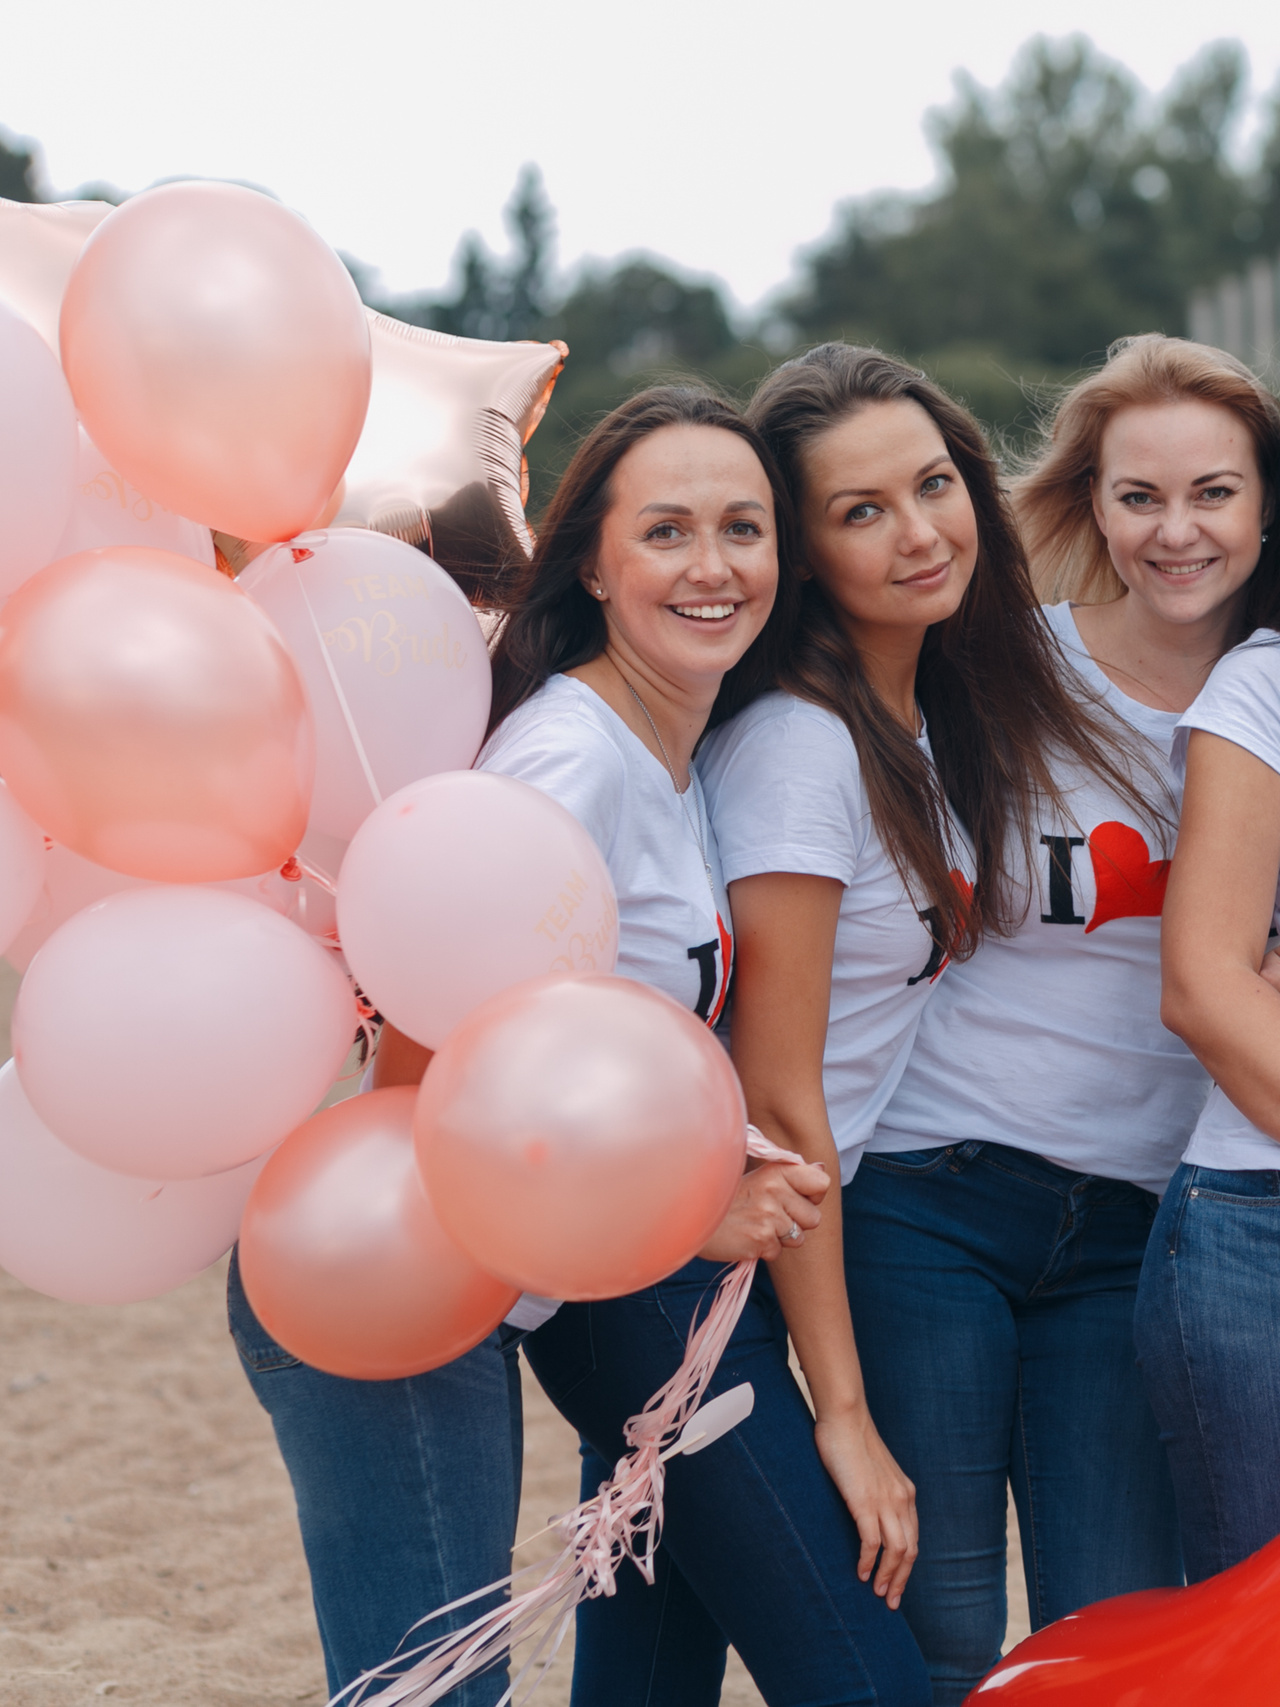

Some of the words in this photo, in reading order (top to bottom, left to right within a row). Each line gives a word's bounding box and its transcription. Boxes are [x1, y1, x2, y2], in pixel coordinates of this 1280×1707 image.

[343, 573, 430, 603] TEAM
[322, 610, 468, 677] Bride
[533, 868, 589, 943] TEAM
[1040, 834, 1085, 925] I
